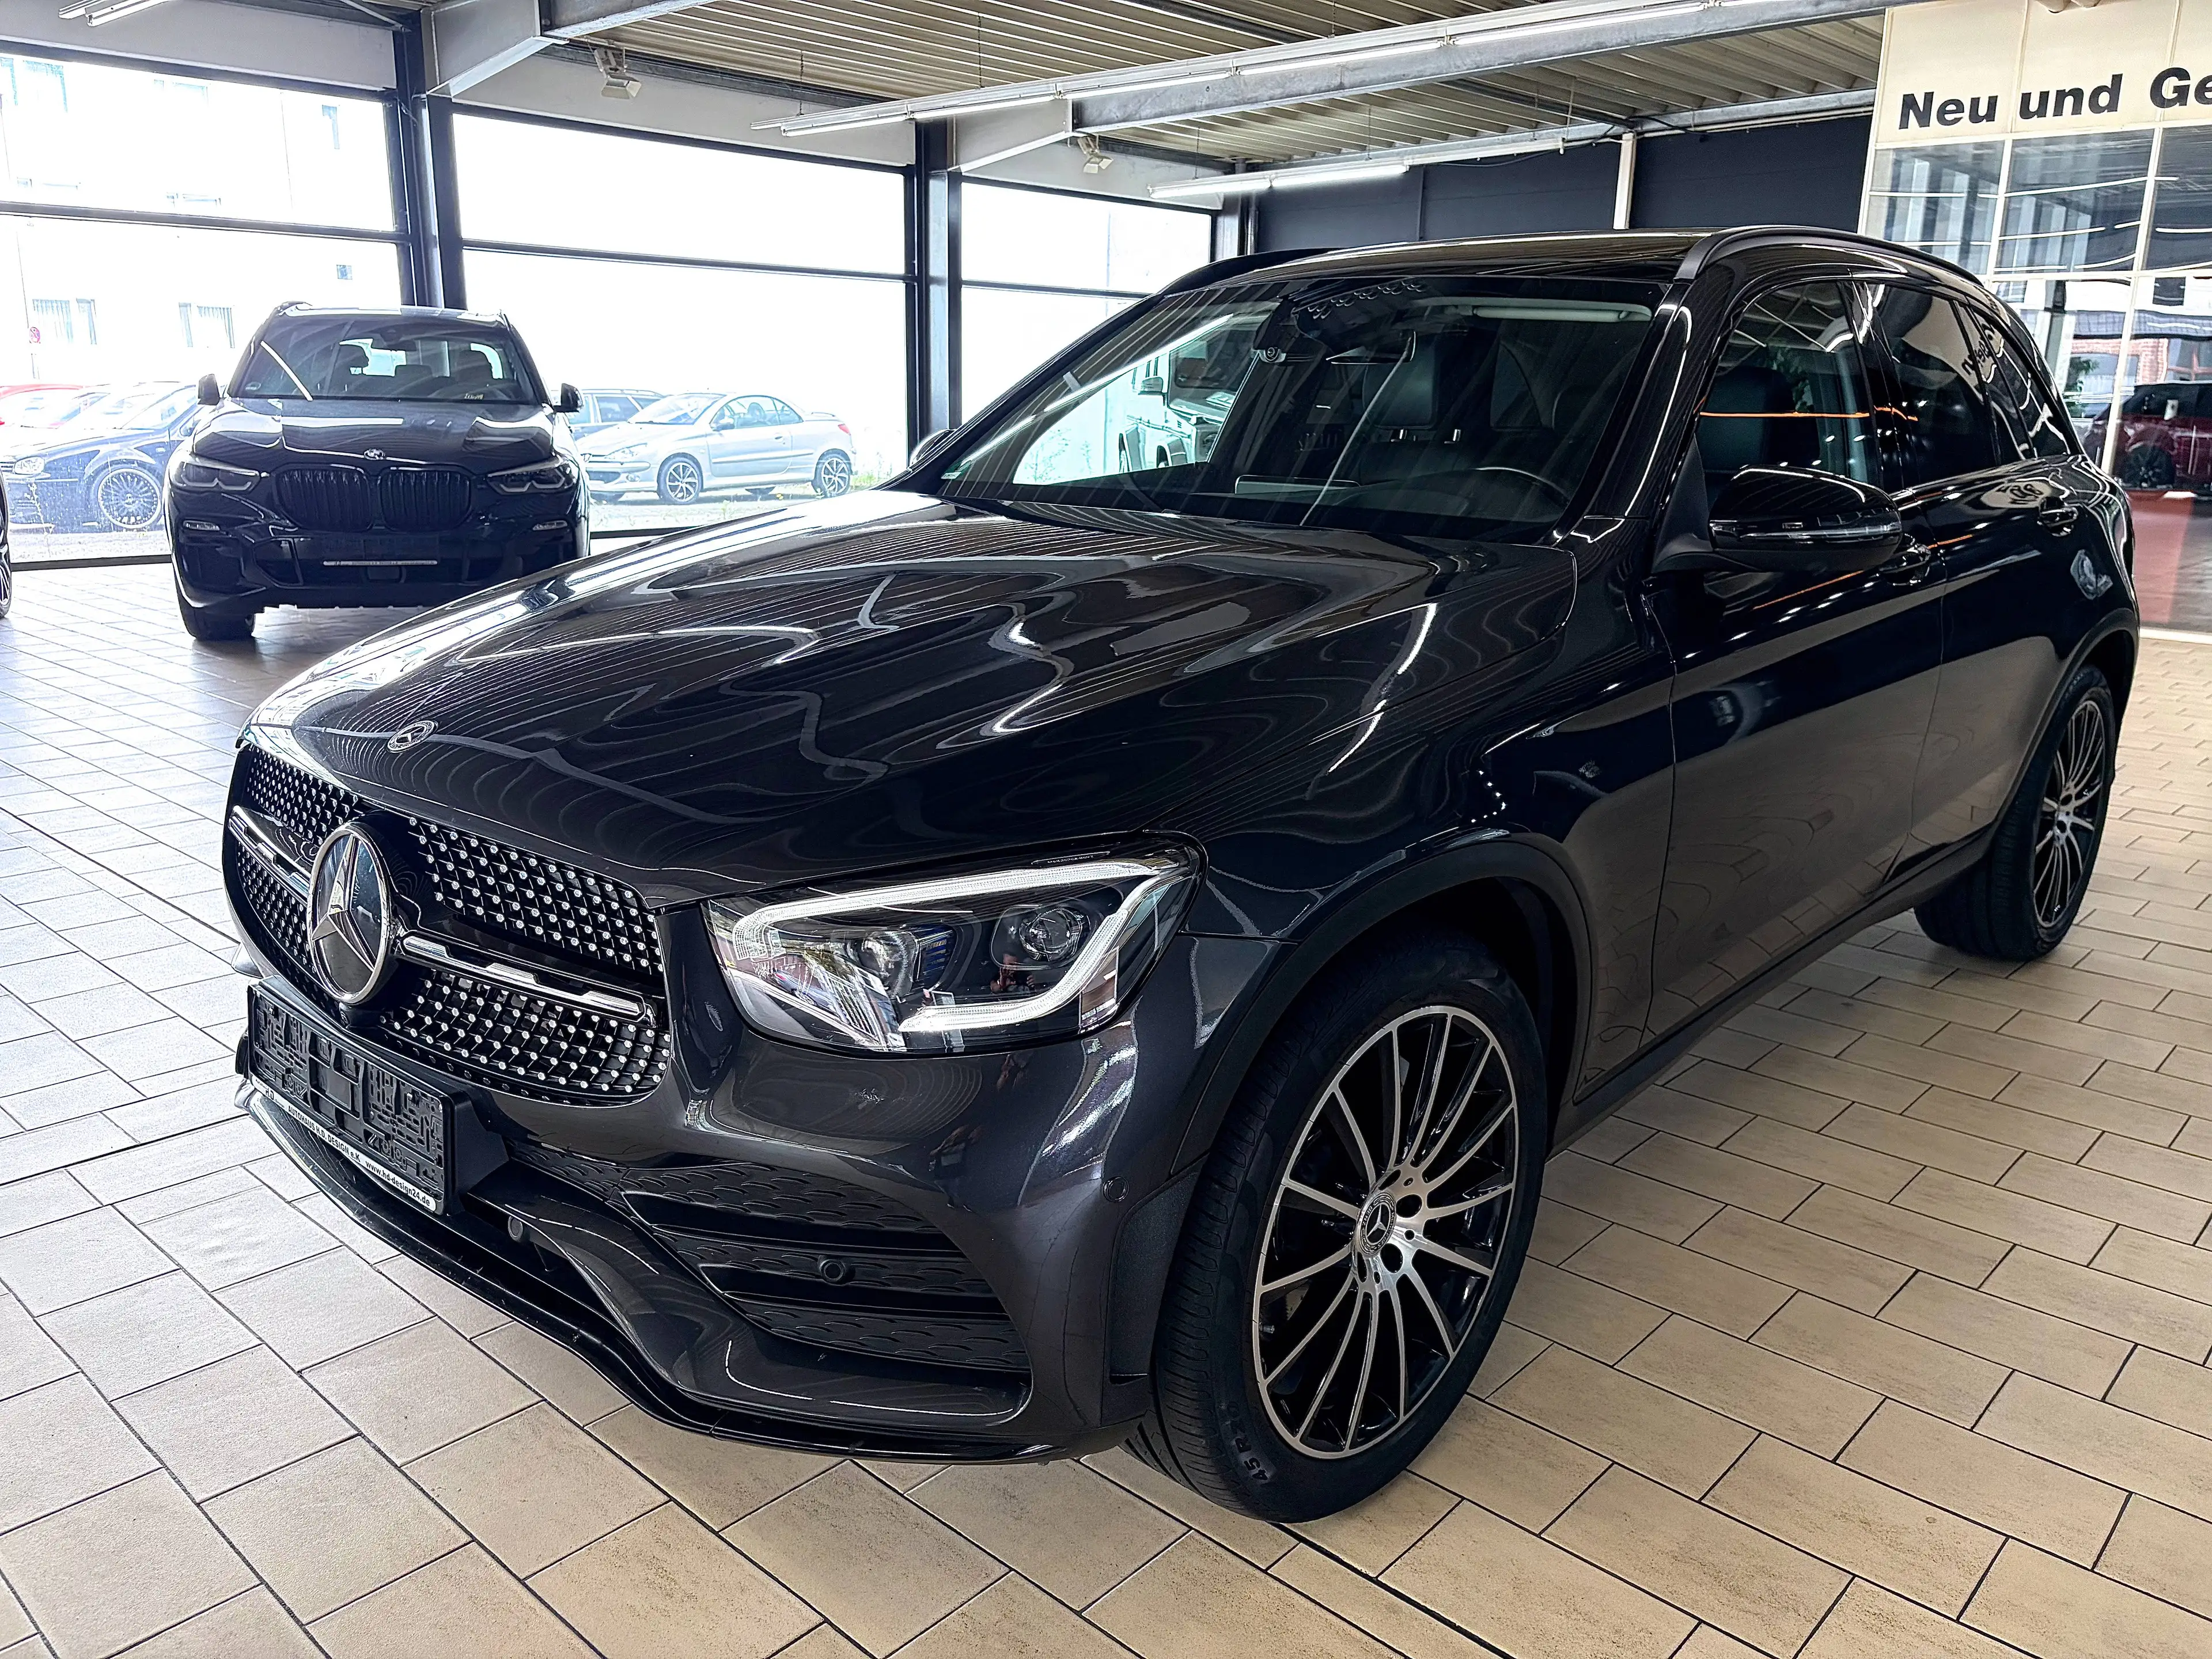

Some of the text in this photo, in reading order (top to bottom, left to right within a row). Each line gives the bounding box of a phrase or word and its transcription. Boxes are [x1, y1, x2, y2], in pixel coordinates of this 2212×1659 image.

[1899, 91, 1998, 130] Neu
[2018, 73, 2123, 120] und
[288, 1105, 315, 1131] AUTOHAUS
[328, 1136, 349, 1155] DESIGN
[365, 1161, 430, 1206] www.hd-design24.de
